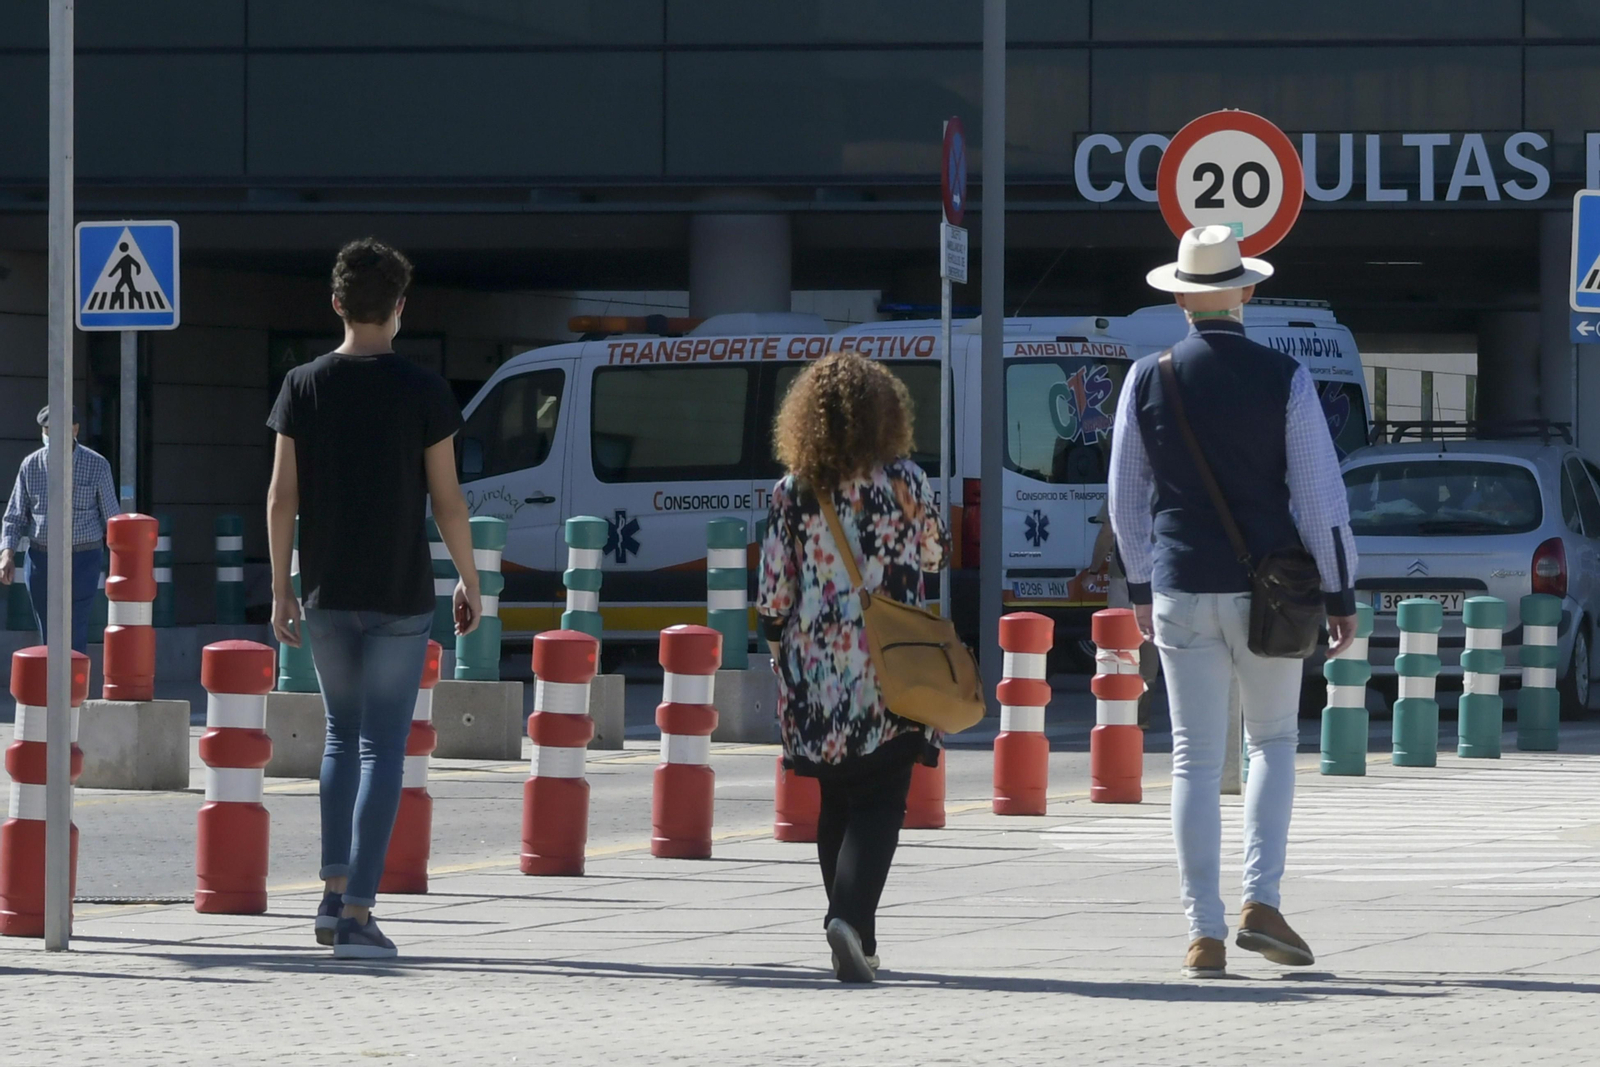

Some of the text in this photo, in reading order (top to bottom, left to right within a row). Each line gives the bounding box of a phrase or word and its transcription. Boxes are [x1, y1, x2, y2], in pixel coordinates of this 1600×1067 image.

[1074, 132, 1551, 203] COULTAS
[1192, 161, 1270, 209] 20
[607, 335, 936, 365] TRANSPORTE COLECTIVO
[1014, 342, 1128, 358] AMBULANCIA
[1299, 331, 1343, 359] MÓVIL
[1049, 365, 1113, 440] CTS
[653, 491, 730, 511] CONSORCIO
[734, 494, 751, 509] DE
[1016, 489, 1109, 502] CONSORCIO DE TRANSPORT
[1020, 582, 1067, 596] 8296 HNX
[1429, 594, 1459, 609] ZY
